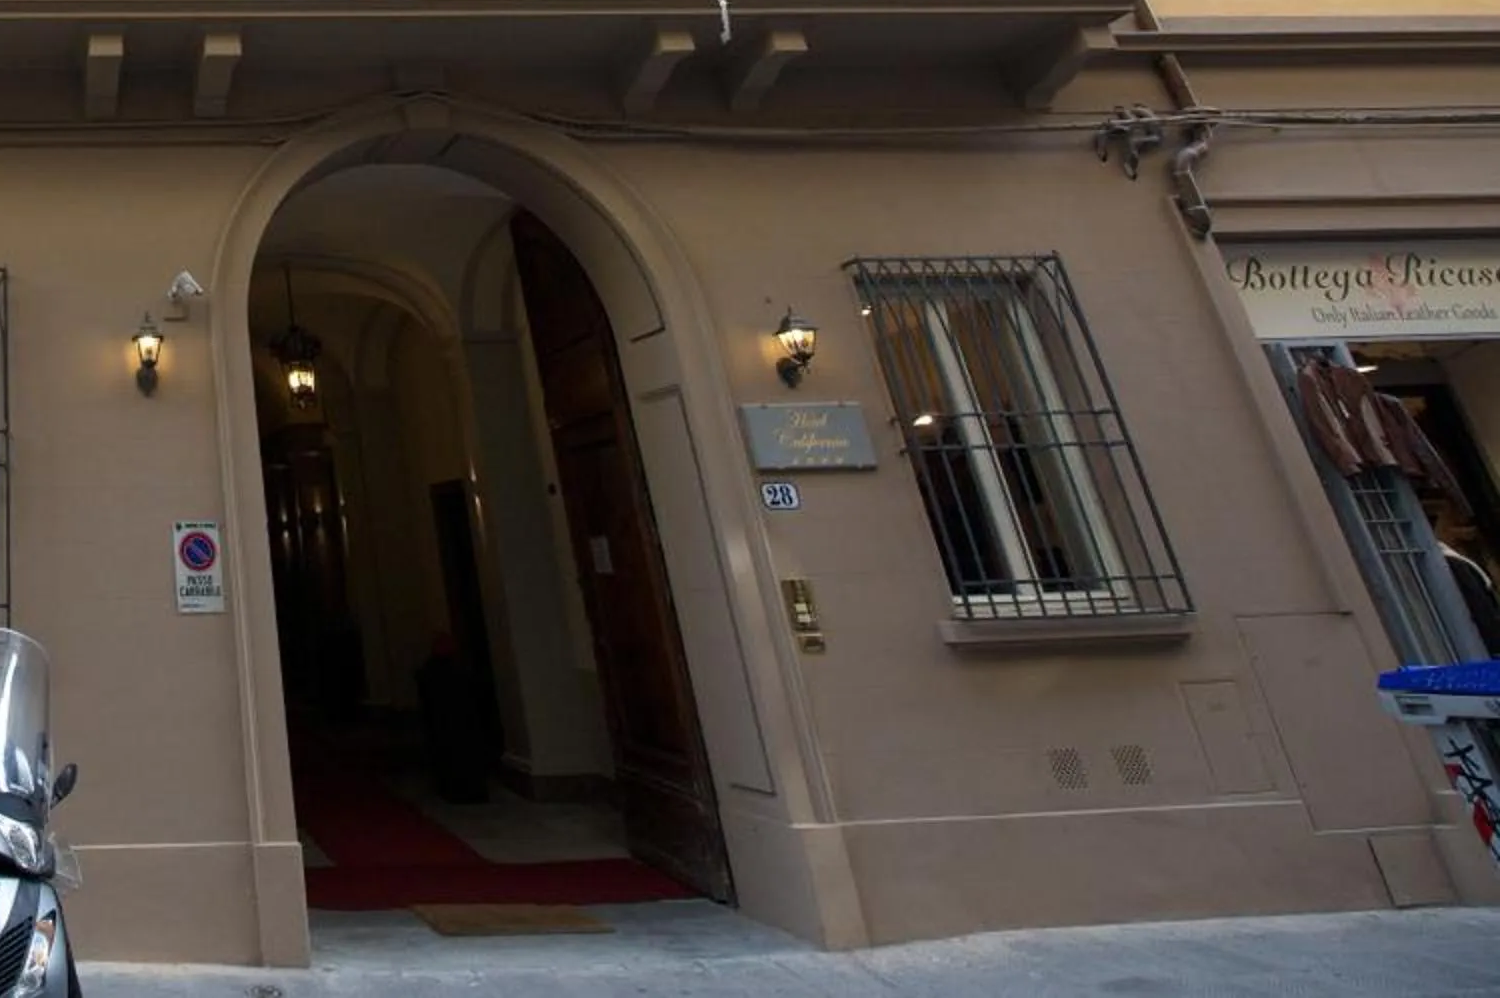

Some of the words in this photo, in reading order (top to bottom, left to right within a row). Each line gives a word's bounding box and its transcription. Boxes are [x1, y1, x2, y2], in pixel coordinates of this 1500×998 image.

[1226, 255, 1374, 303] Bottega
[1310, 305, 1348, 328] Only
[1350, 305, 1396, 323] Italian
[766, 485, 793, 506] 28
